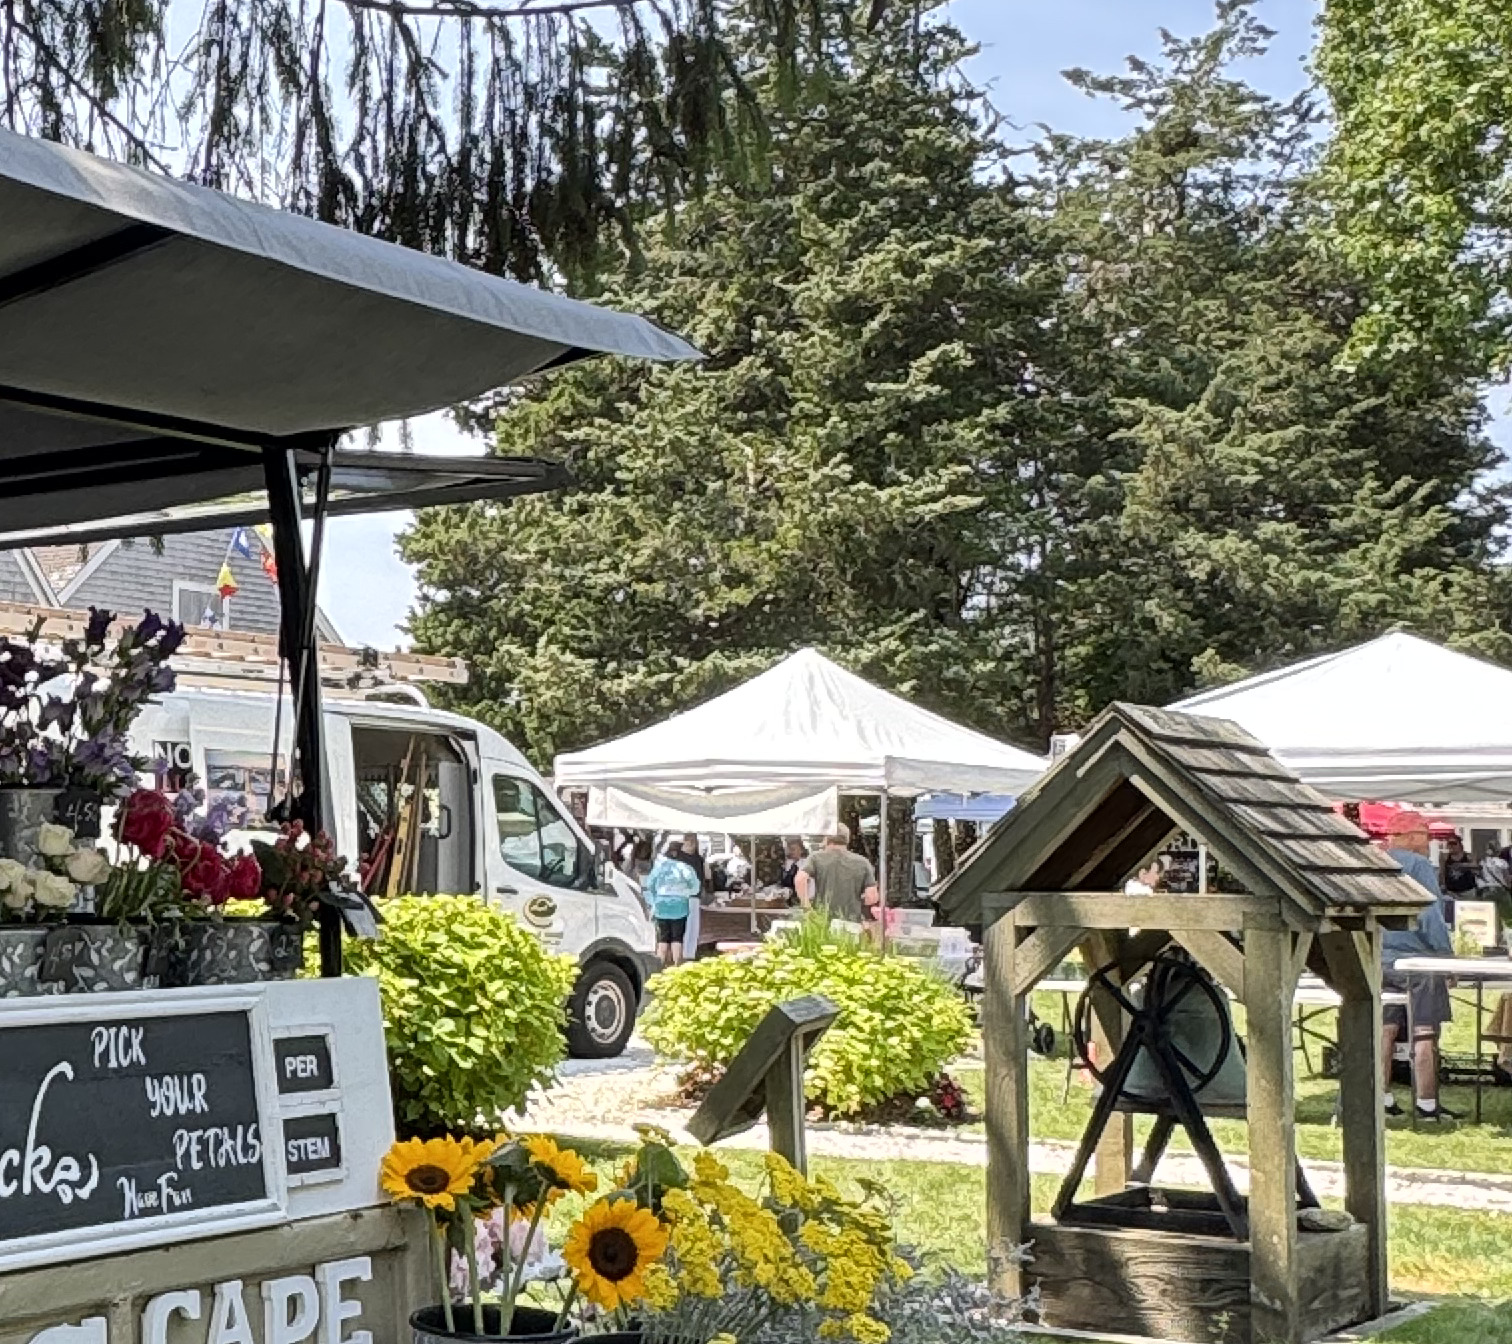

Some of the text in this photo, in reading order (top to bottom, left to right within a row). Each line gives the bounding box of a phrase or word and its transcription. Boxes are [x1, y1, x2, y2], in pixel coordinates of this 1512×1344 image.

[91, 1025, 147, 1068] PICK
[284, 1054, 320, 1079] PER
[145, 1073, 209, 1118] YOUR
[173, 1123, 262, 1170] PETALS
[288, 1136, 332, 1162] STEM
